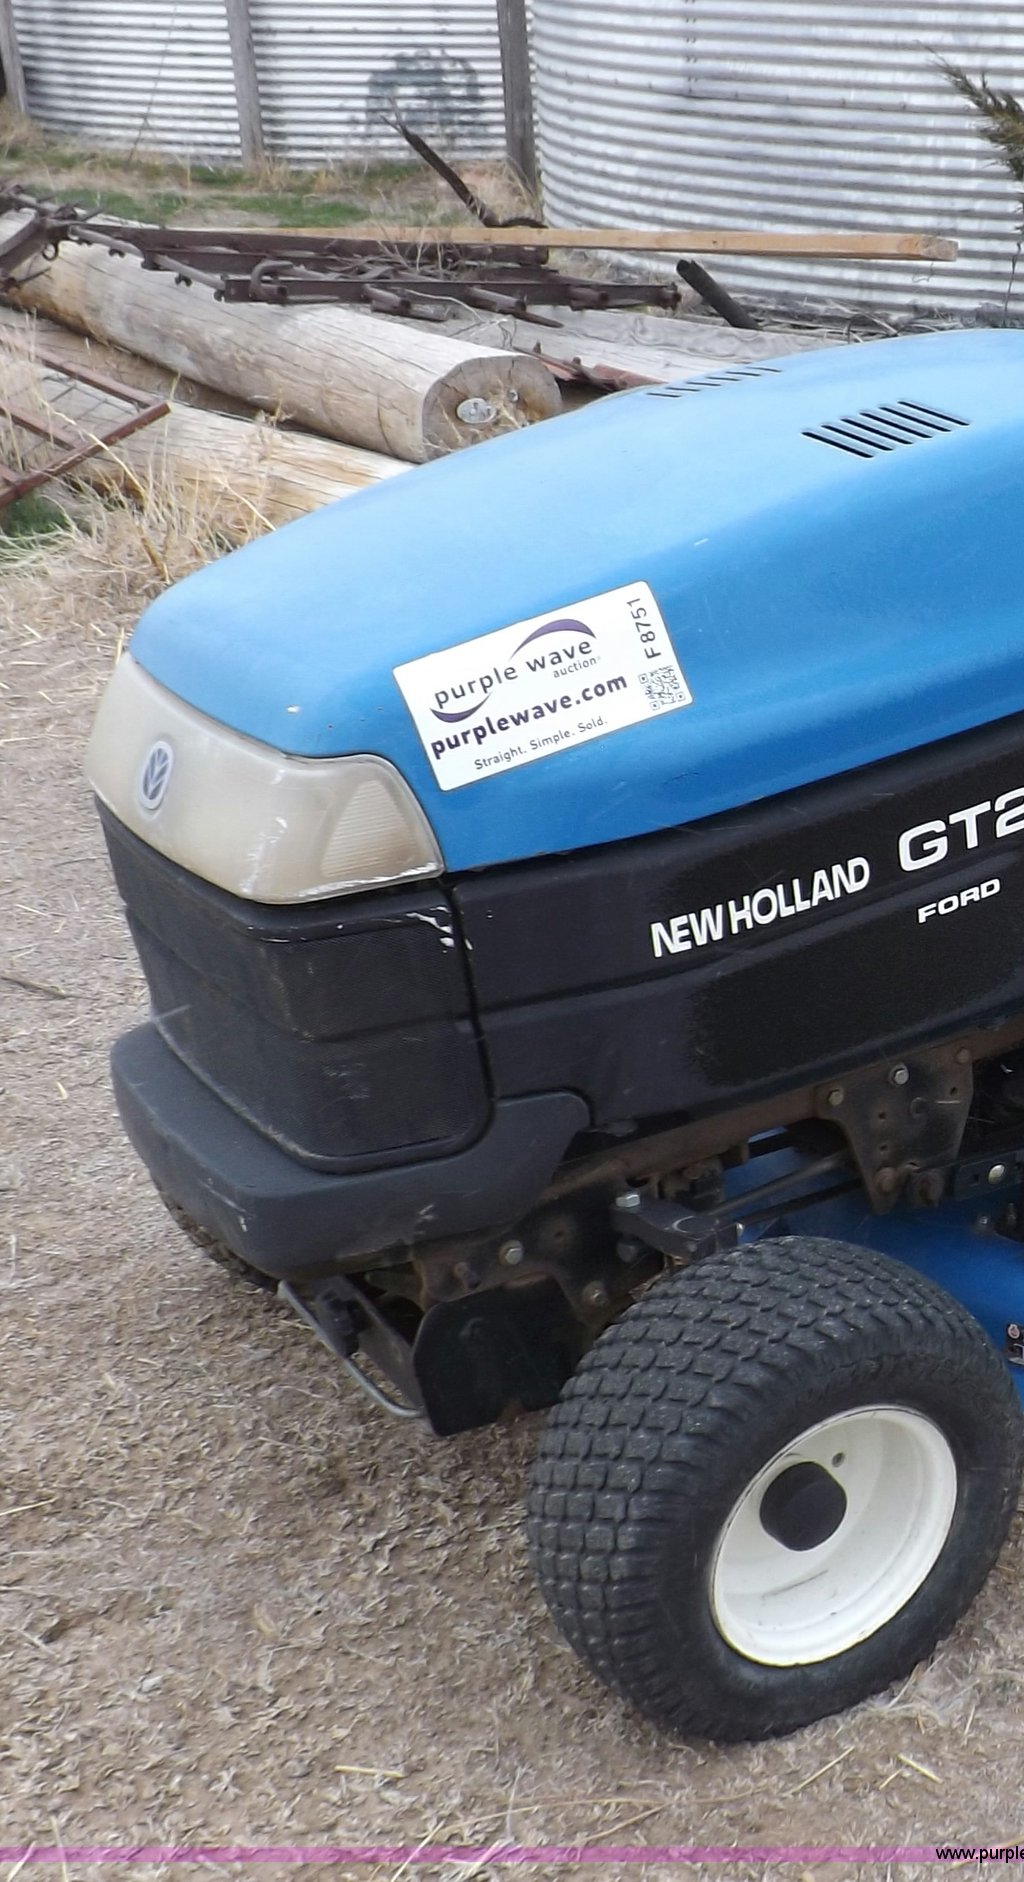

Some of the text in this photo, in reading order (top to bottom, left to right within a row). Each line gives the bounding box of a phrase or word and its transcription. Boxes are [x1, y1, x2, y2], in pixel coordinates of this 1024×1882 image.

[434, 641, 593, 709] purple wave
[552, 655, 597, 679] auction
[430, 675, 628, 760] purplewave.com
[474, 715, 608, 770] Straight. Simple. Sold.
[650, 856, 871, 958] NEW HOLLAND
[917, 878, 1000, 924] FORD
